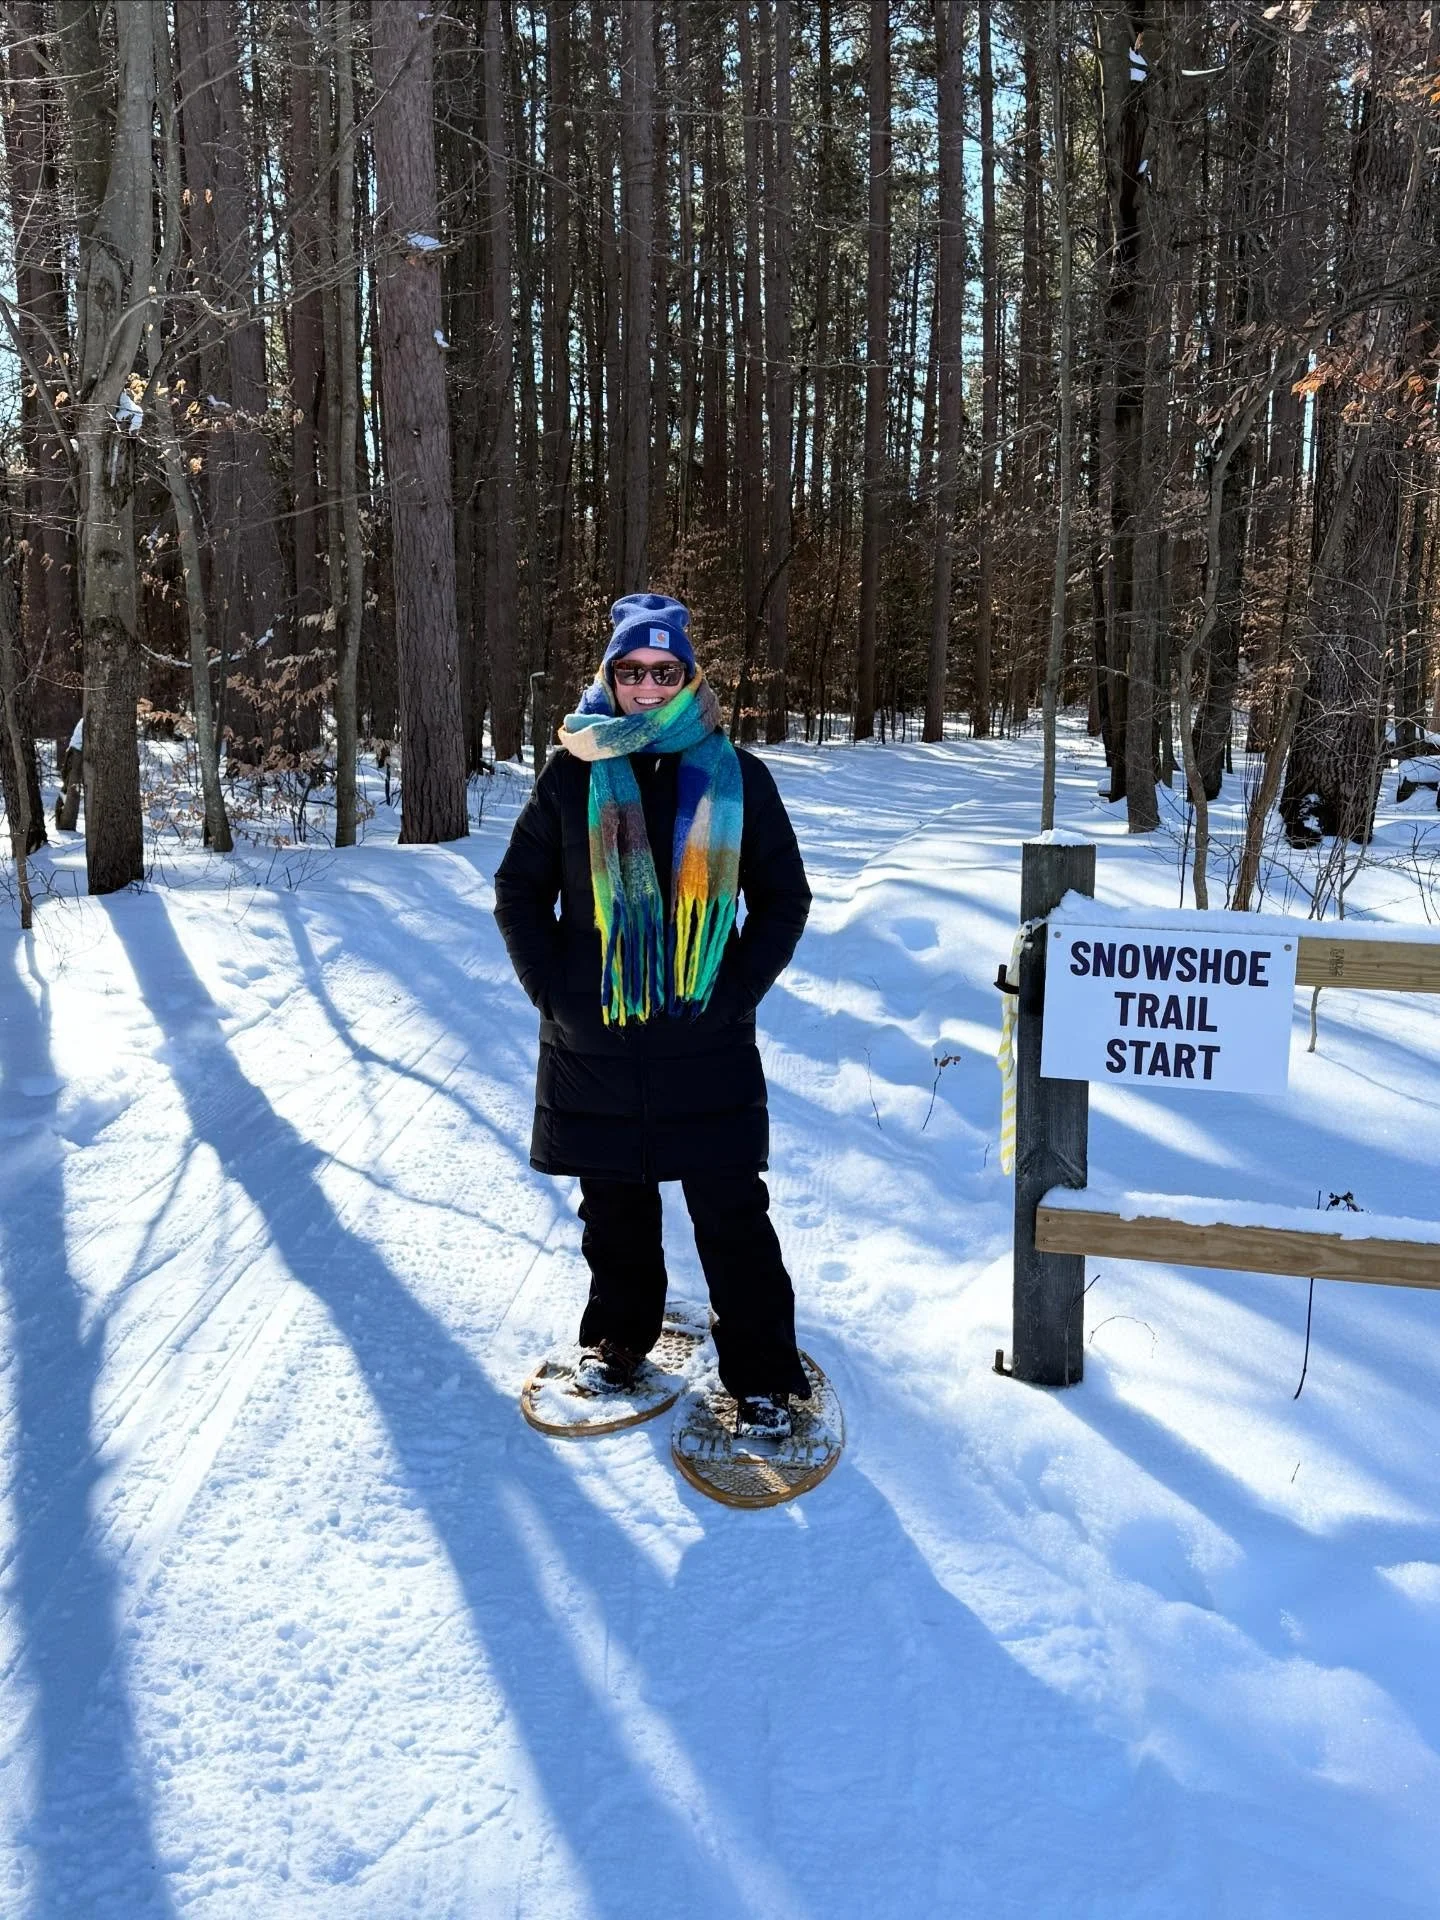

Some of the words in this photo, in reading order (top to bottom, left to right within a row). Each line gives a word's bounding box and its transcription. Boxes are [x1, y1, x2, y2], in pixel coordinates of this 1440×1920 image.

[1069, 940, 1272, 988] SNOWSHOE
[1113, 991, 1218, 1033] TRAIL
[1105, 1038, 1221, 1081] START
